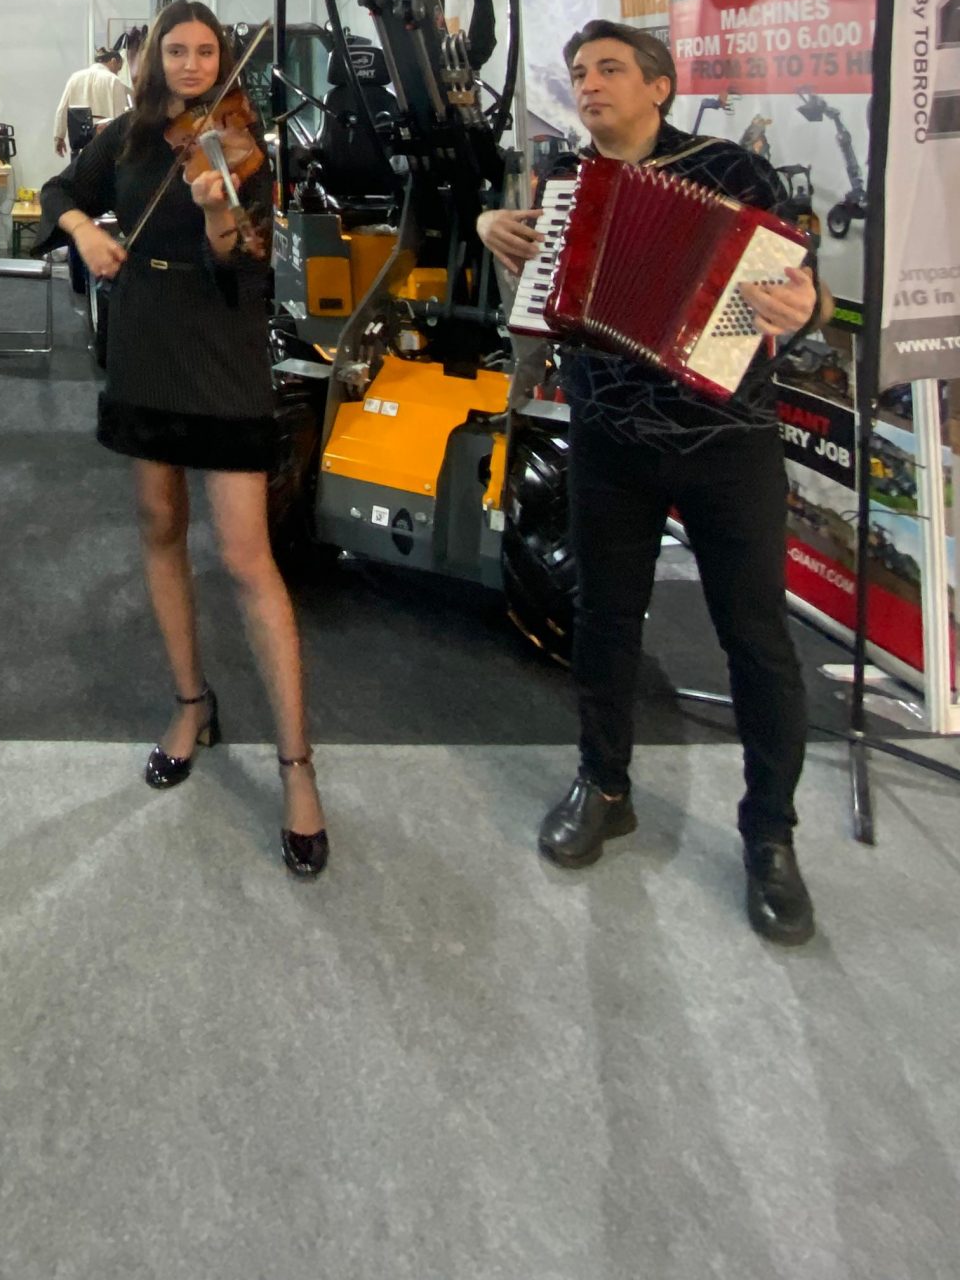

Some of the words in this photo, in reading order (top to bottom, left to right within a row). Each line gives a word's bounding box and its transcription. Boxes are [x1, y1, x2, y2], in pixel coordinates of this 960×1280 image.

[676, 36, 720, 58] FROM
[725, 32, 757, 54] 750
[763, 28, 790, 51] TO
[797, 21, 861, 50] 6.000
[691, 58, 739, 80] FROM
[774, 53, 803, 77] TO
[809, 52, 838, 76] 75
[912, 26, 929, 144] TOBROCO
[935, 288, 955, 304] in
[815, 438, 851, 468] JOB
